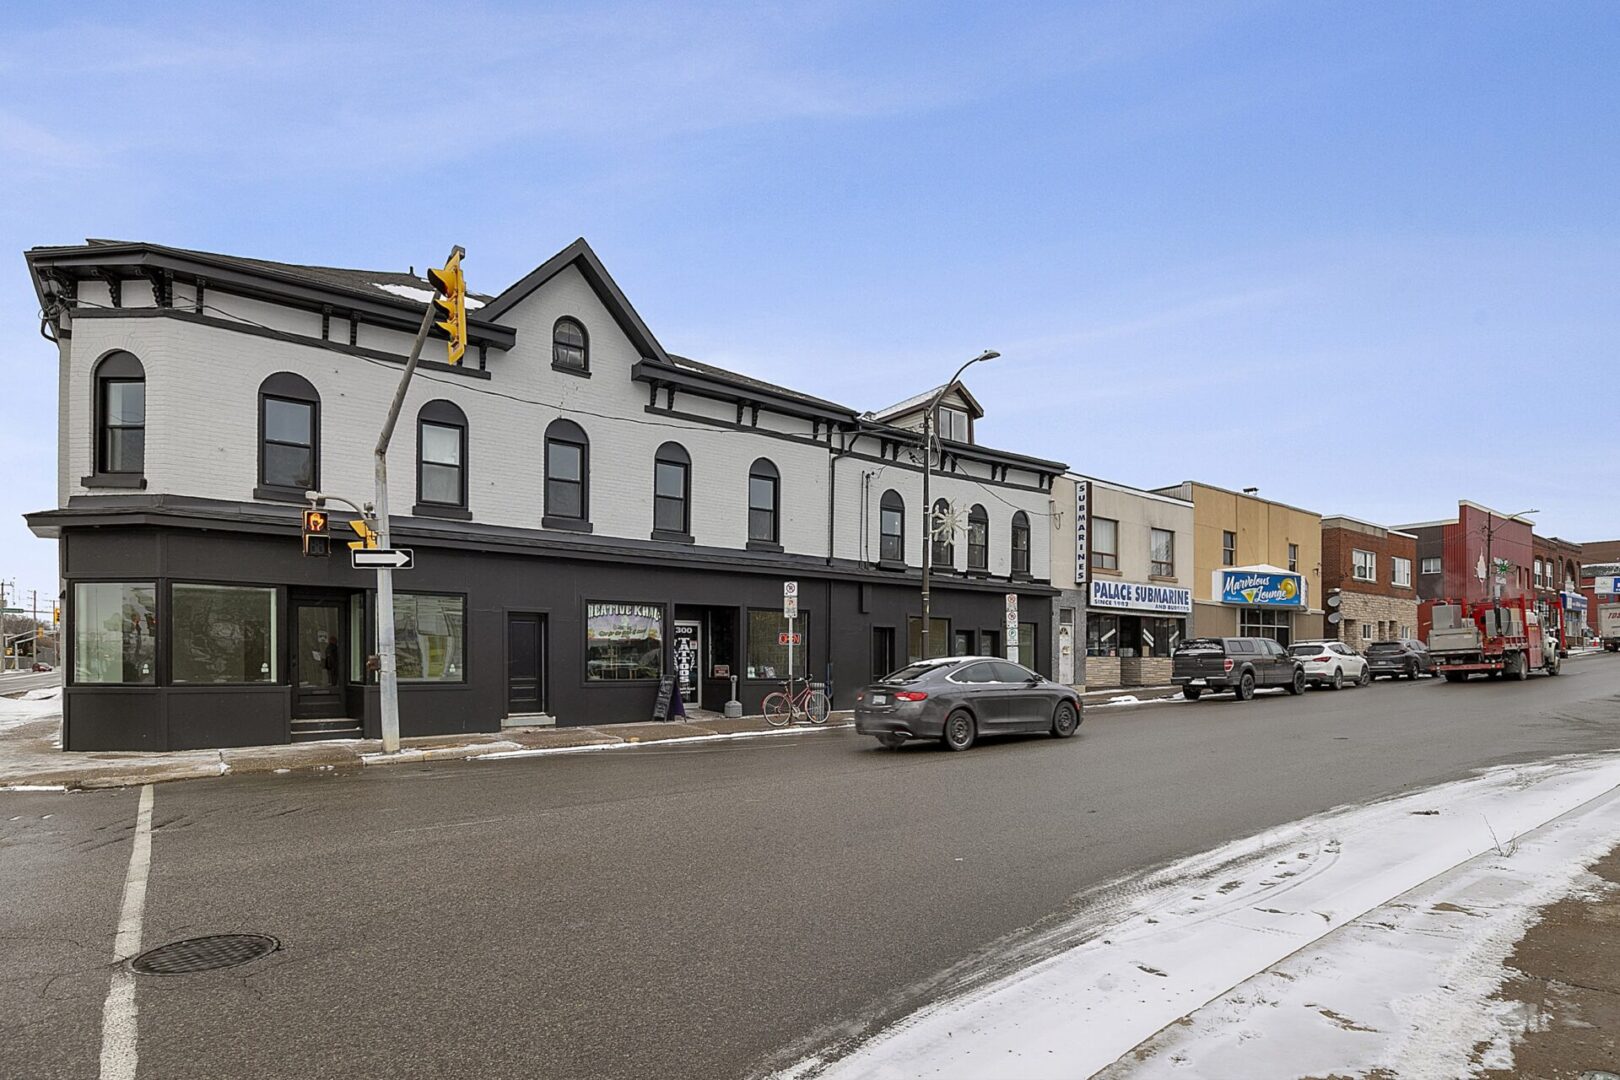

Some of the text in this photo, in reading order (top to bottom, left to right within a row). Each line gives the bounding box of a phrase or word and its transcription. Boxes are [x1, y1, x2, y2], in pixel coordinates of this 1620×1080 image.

[1077, 485, 1086, 579] SUBMARINES
[1094, 582, 1190, 605] PALACE SUBMARINE
[1223, 574, 1271, 595] Marvelous
[1255, 586, 1287, 602] Lounge
[678, 637, 690, 683] TATTOOS
